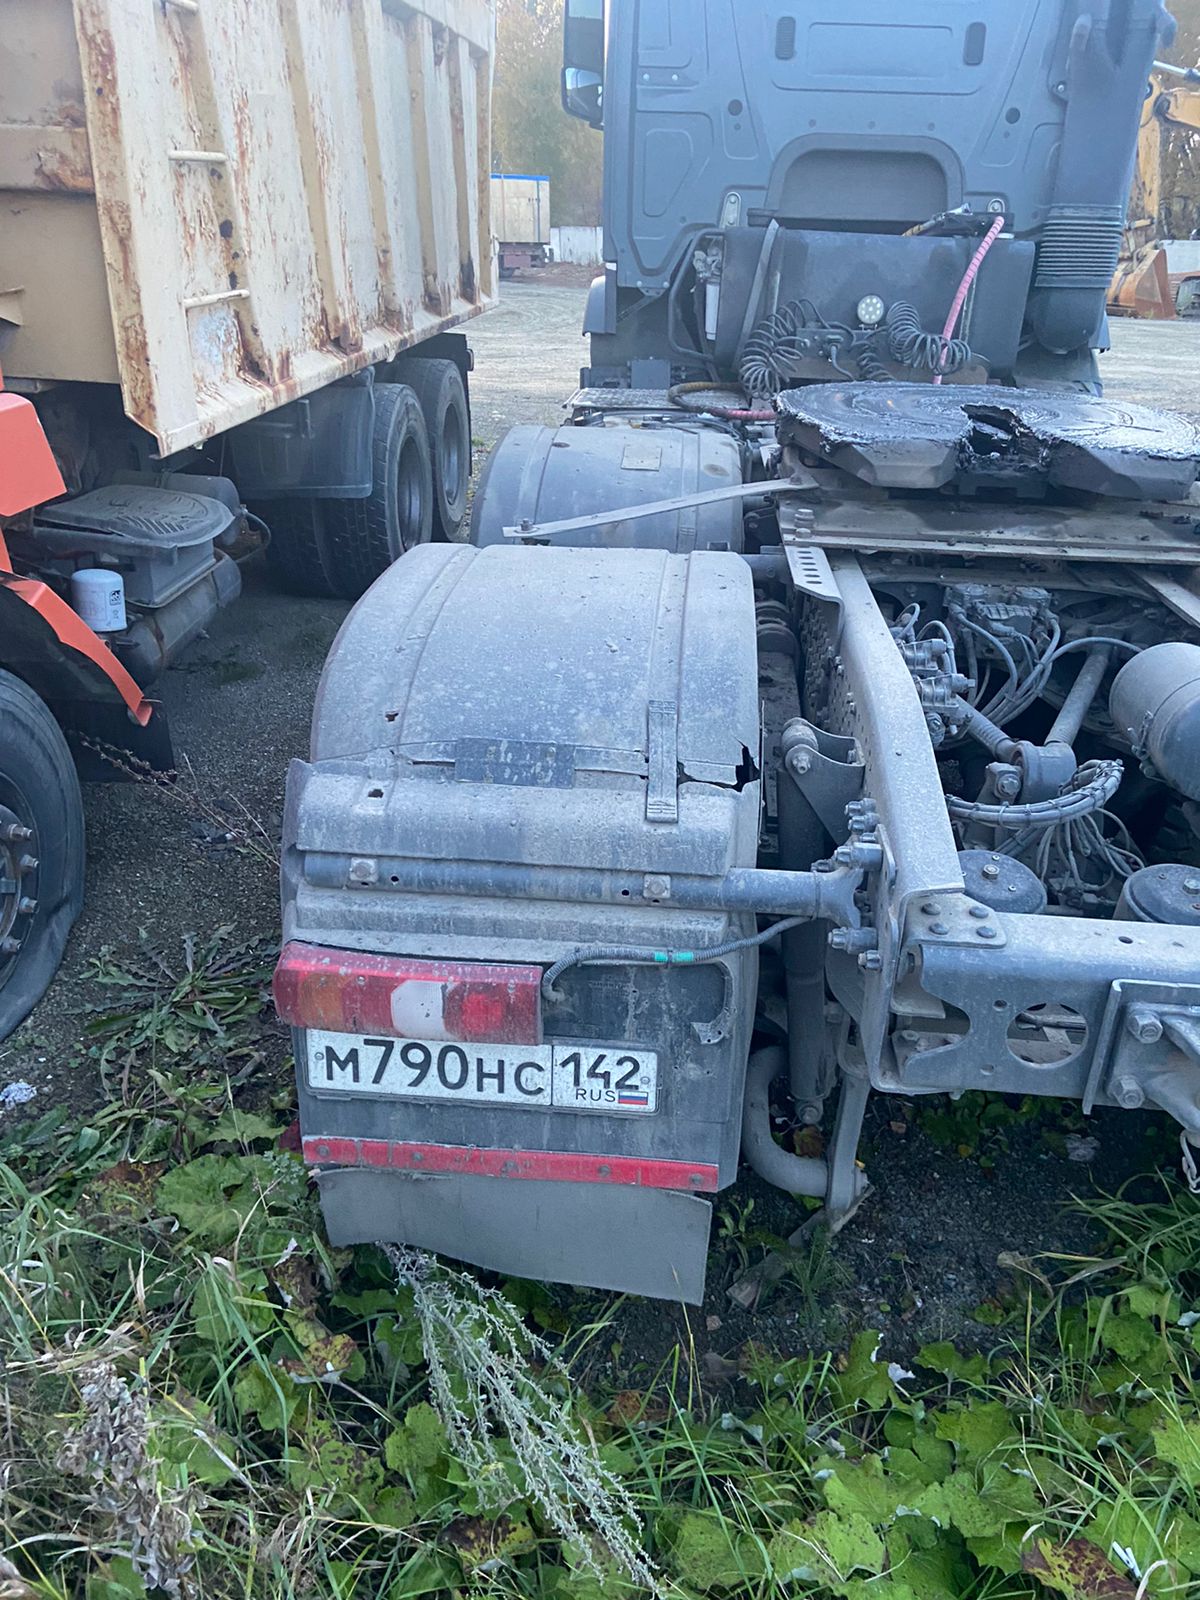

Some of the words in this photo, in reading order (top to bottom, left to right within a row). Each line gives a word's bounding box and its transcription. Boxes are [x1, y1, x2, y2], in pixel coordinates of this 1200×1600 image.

[325, 1039, 545, 1096] М790НС
[559, 1051, 641, 1091] 142
[575, 1088, 616, 1103] RUS
